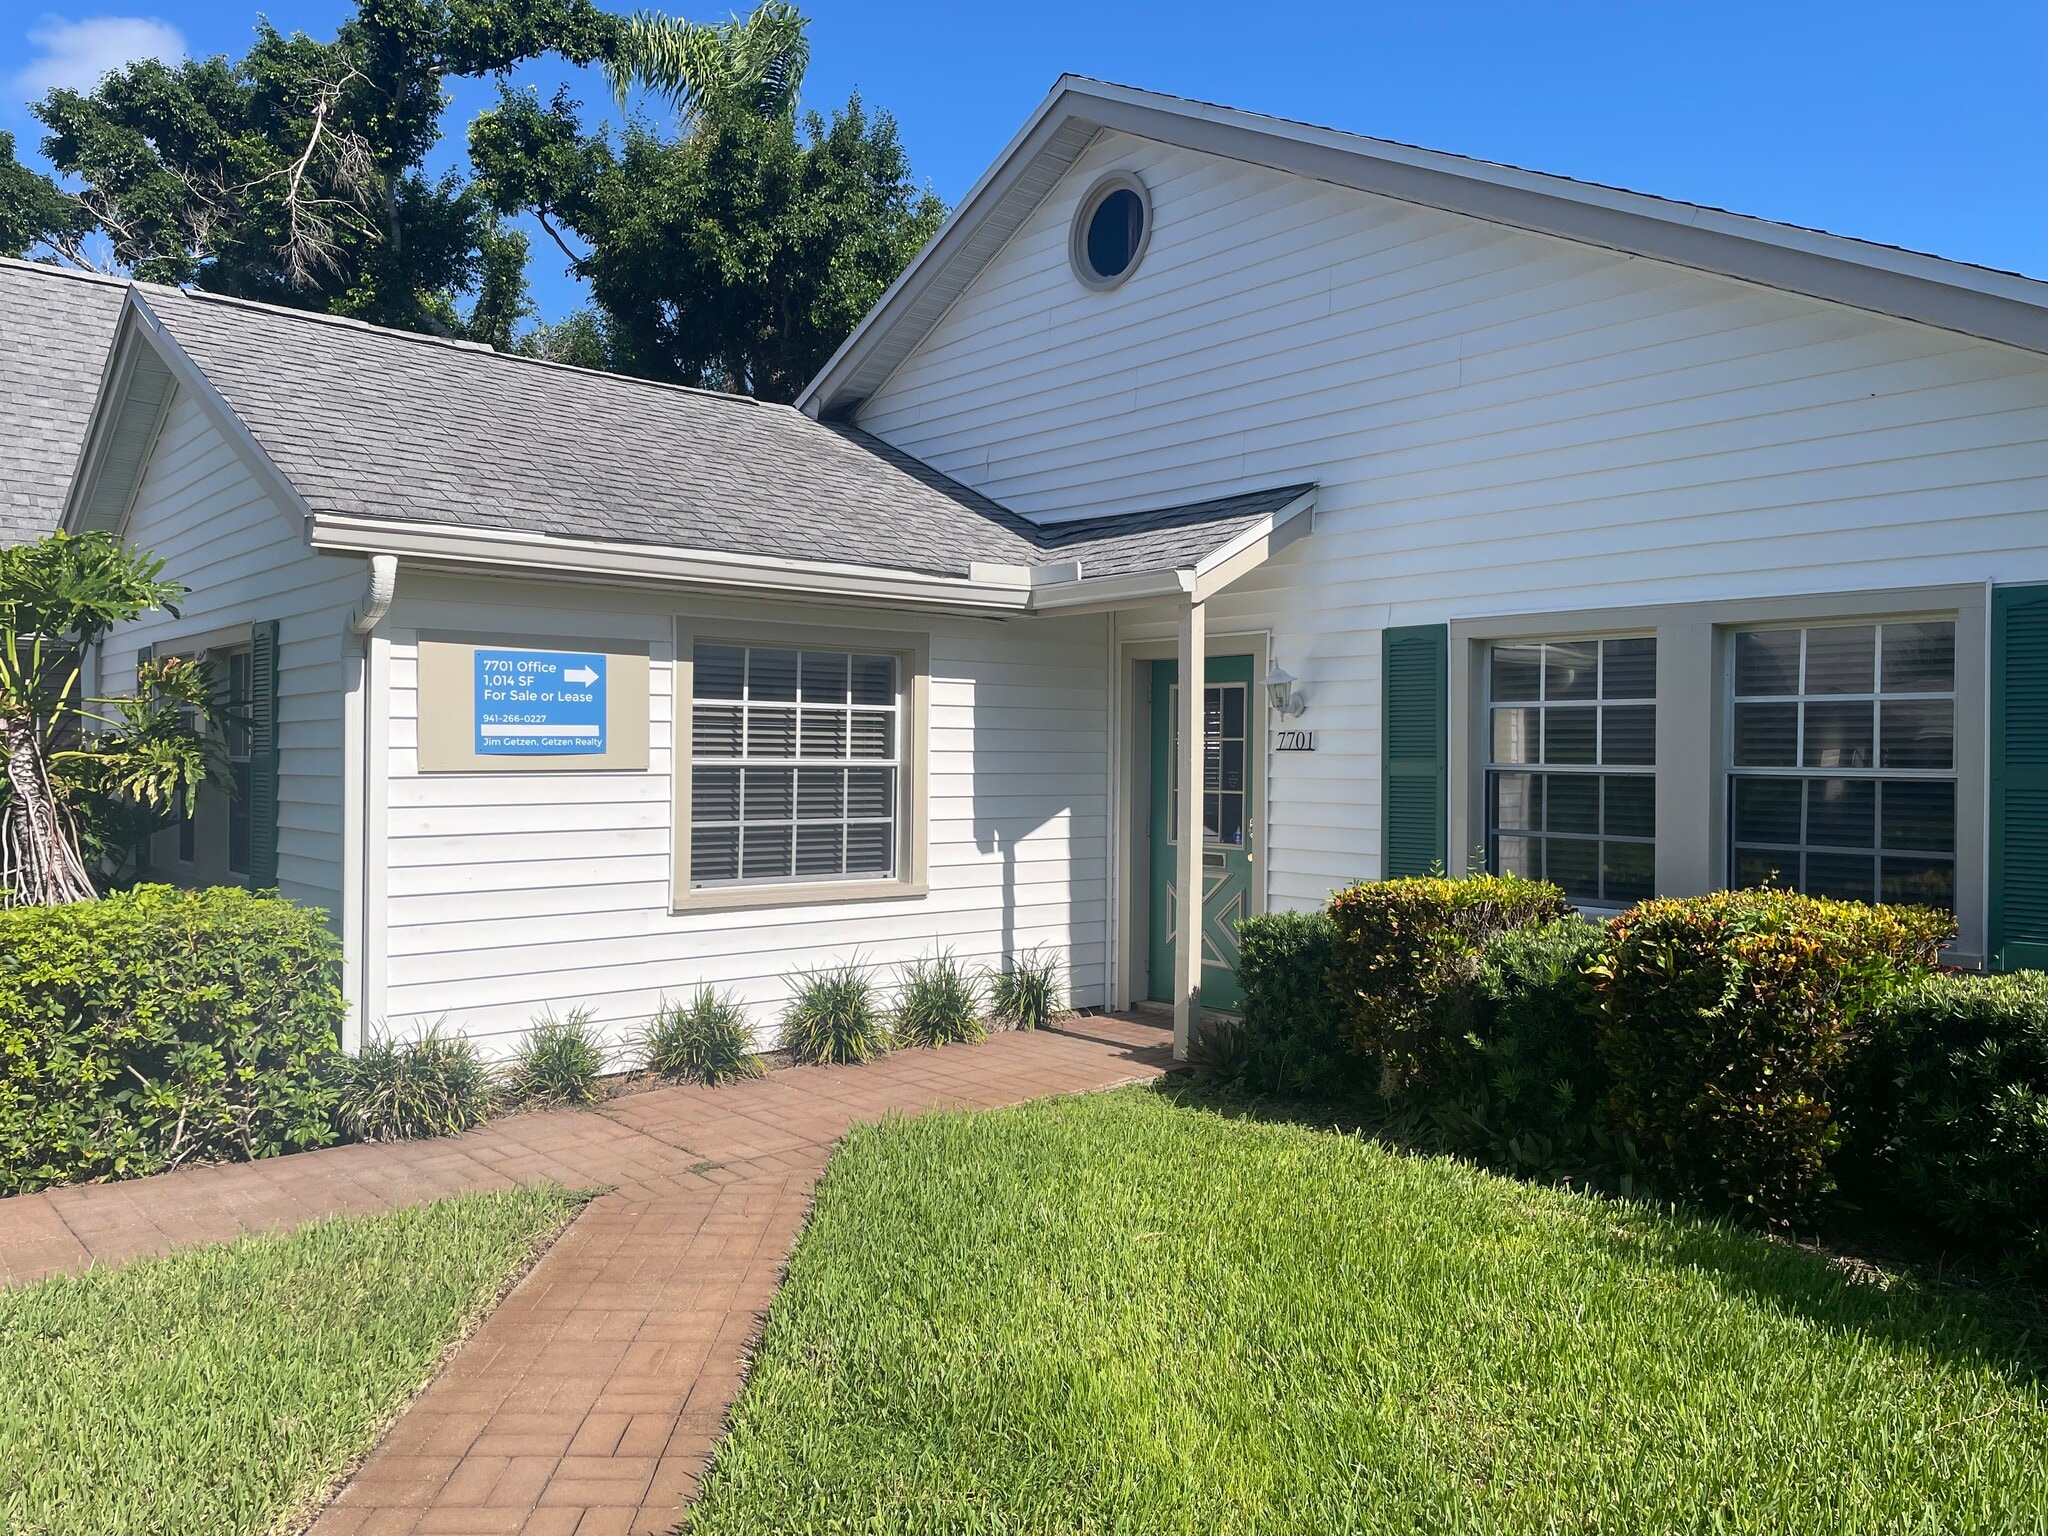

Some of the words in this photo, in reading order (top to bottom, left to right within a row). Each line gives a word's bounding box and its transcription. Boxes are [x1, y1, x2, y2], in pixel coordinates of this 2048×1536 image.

[483, 660, 513, 672] 7701
[517, 661, 557, 673] Office
[483, 675, 515, 687] 1,014
[518, 676, 535, 687] SF
[484, 689, 506, 701] For
[510, 690, 538, 701] Sale
[541, 693, 555, 702] or
[558, 691, 593, 702] Lease
[483, 714, 547, 723] 941-266-0227
[483, 738, 501, 746] Jim
[503, 738, 540, 747] Getzen,
[541, 738, 573, 746] Getzen
[575, 738, 602, 747] Realty
[1277, 731, 1313, 750] 7701
